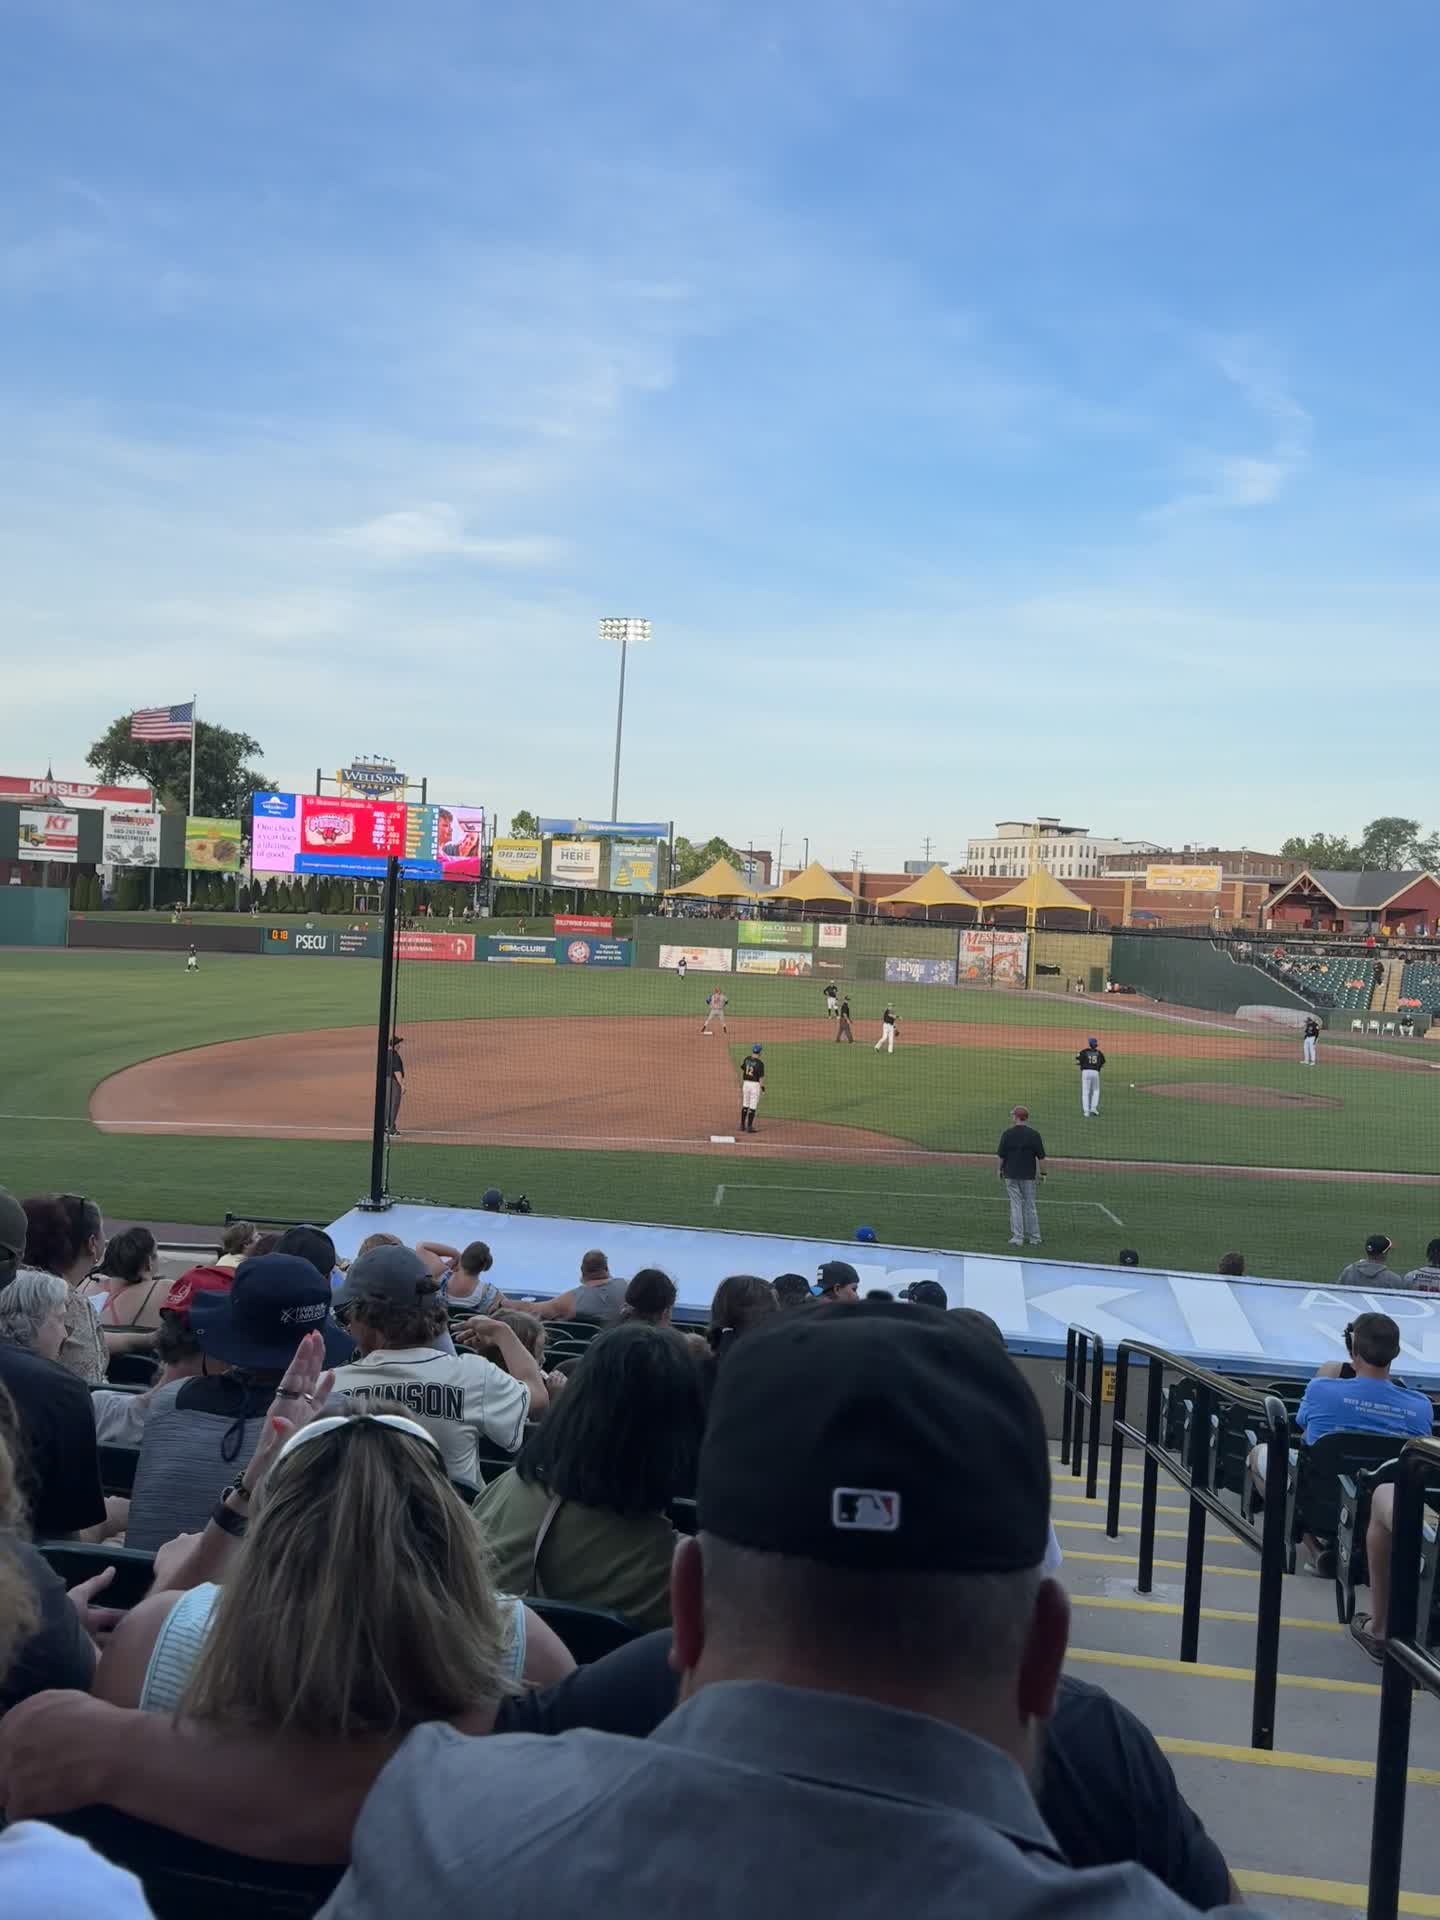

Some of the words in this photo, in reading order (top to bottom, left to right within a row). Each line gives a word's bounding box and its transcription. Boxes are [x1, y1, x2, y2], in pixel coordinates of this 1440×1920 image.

[29, 780, 98, 797] KINSLEY
[560, 850, 592, 861] HERE
[295, 934, 326, 950] PSECU
